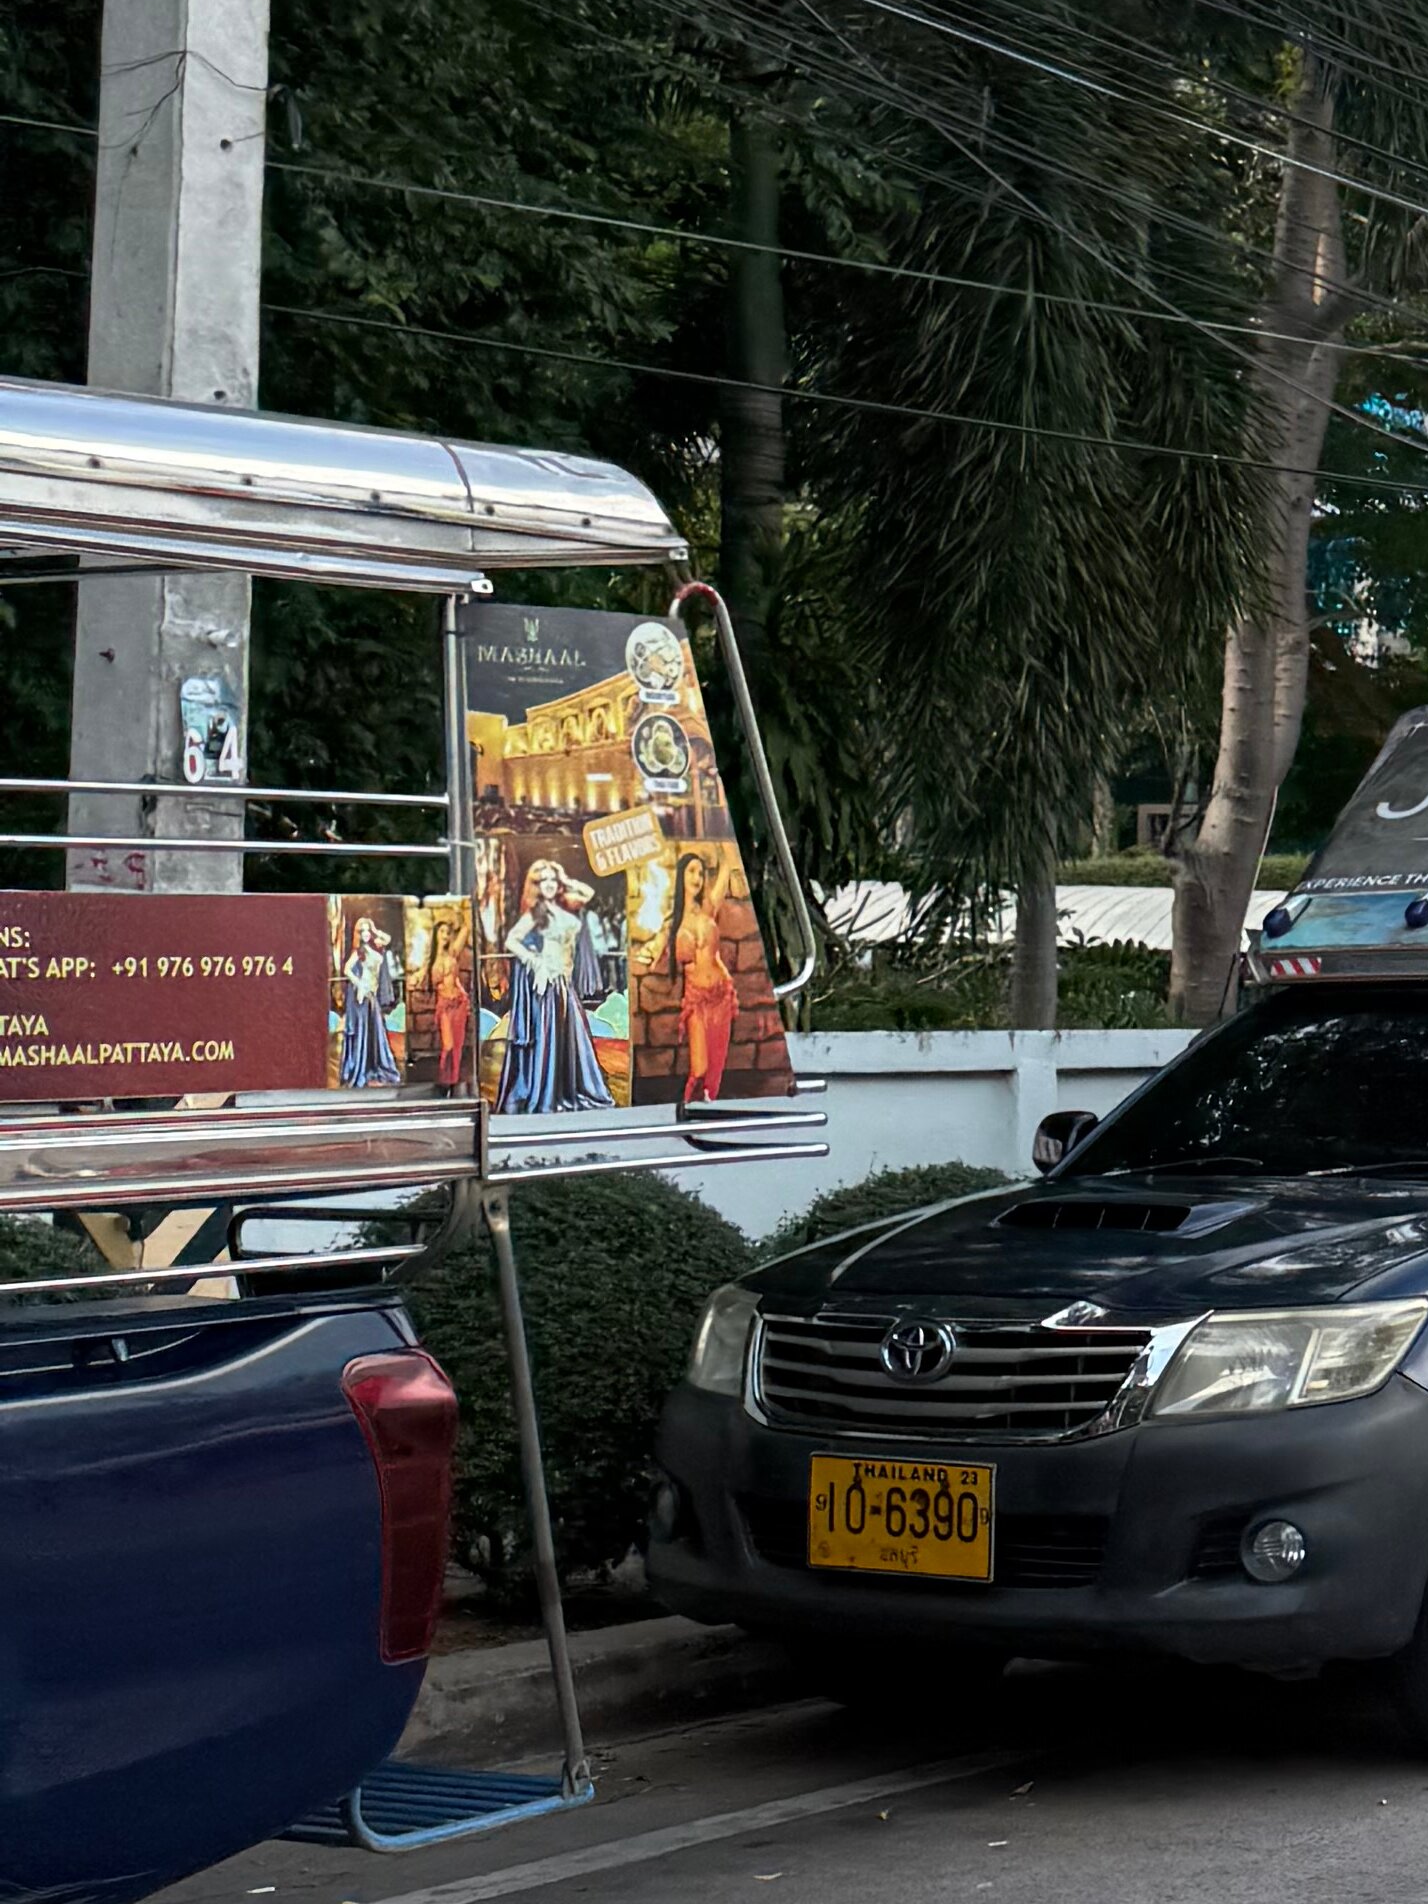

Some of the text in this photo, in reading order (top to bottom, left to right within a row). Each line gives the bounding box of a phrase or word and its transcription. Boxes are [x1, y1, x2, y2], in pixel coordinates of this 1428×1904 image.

[46, 956, 96, 979] APP:
[111, 956, 149, 978] +91
[157, 956, 194, 978] 976
[200, 955, 236, 977] 976
[242, 955, 277, 977] 976
[282, 955, 294, 976] 4
[853, 1462, 979, 1486] THAILAND 23
[828, 1481, 979, 1543] 10-6390
